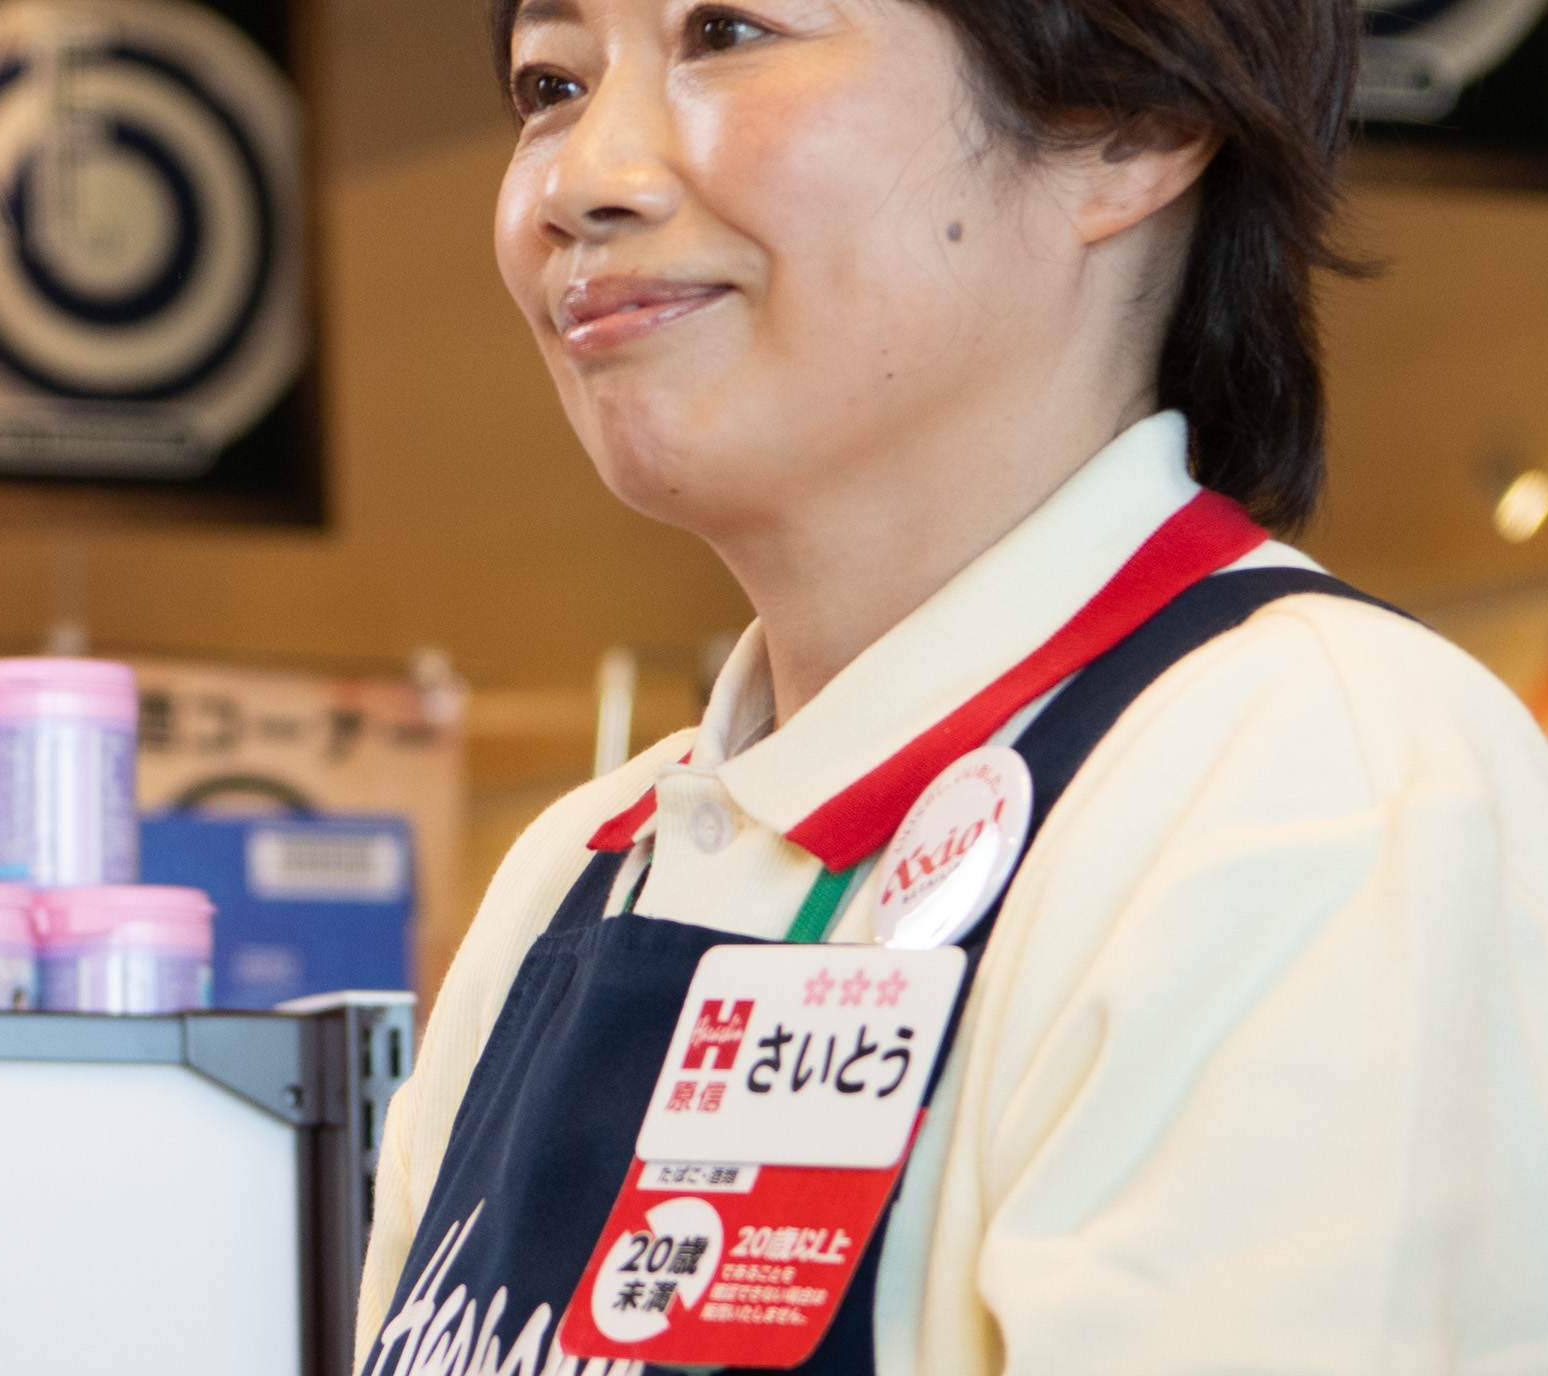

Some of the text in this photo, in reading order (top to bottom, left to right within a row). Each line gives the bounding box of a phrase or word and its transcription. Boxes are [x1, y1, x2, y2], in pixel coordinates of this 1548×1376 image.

[744, 1023, 916, 1099] さいとう
[664, 1079, 728, 1113] 原信
[615, 1232, 711, 1277] 20歳
[727, 1224, 853, 1266] 20歳以上
[610, 1278, 680, 1316] 未満
